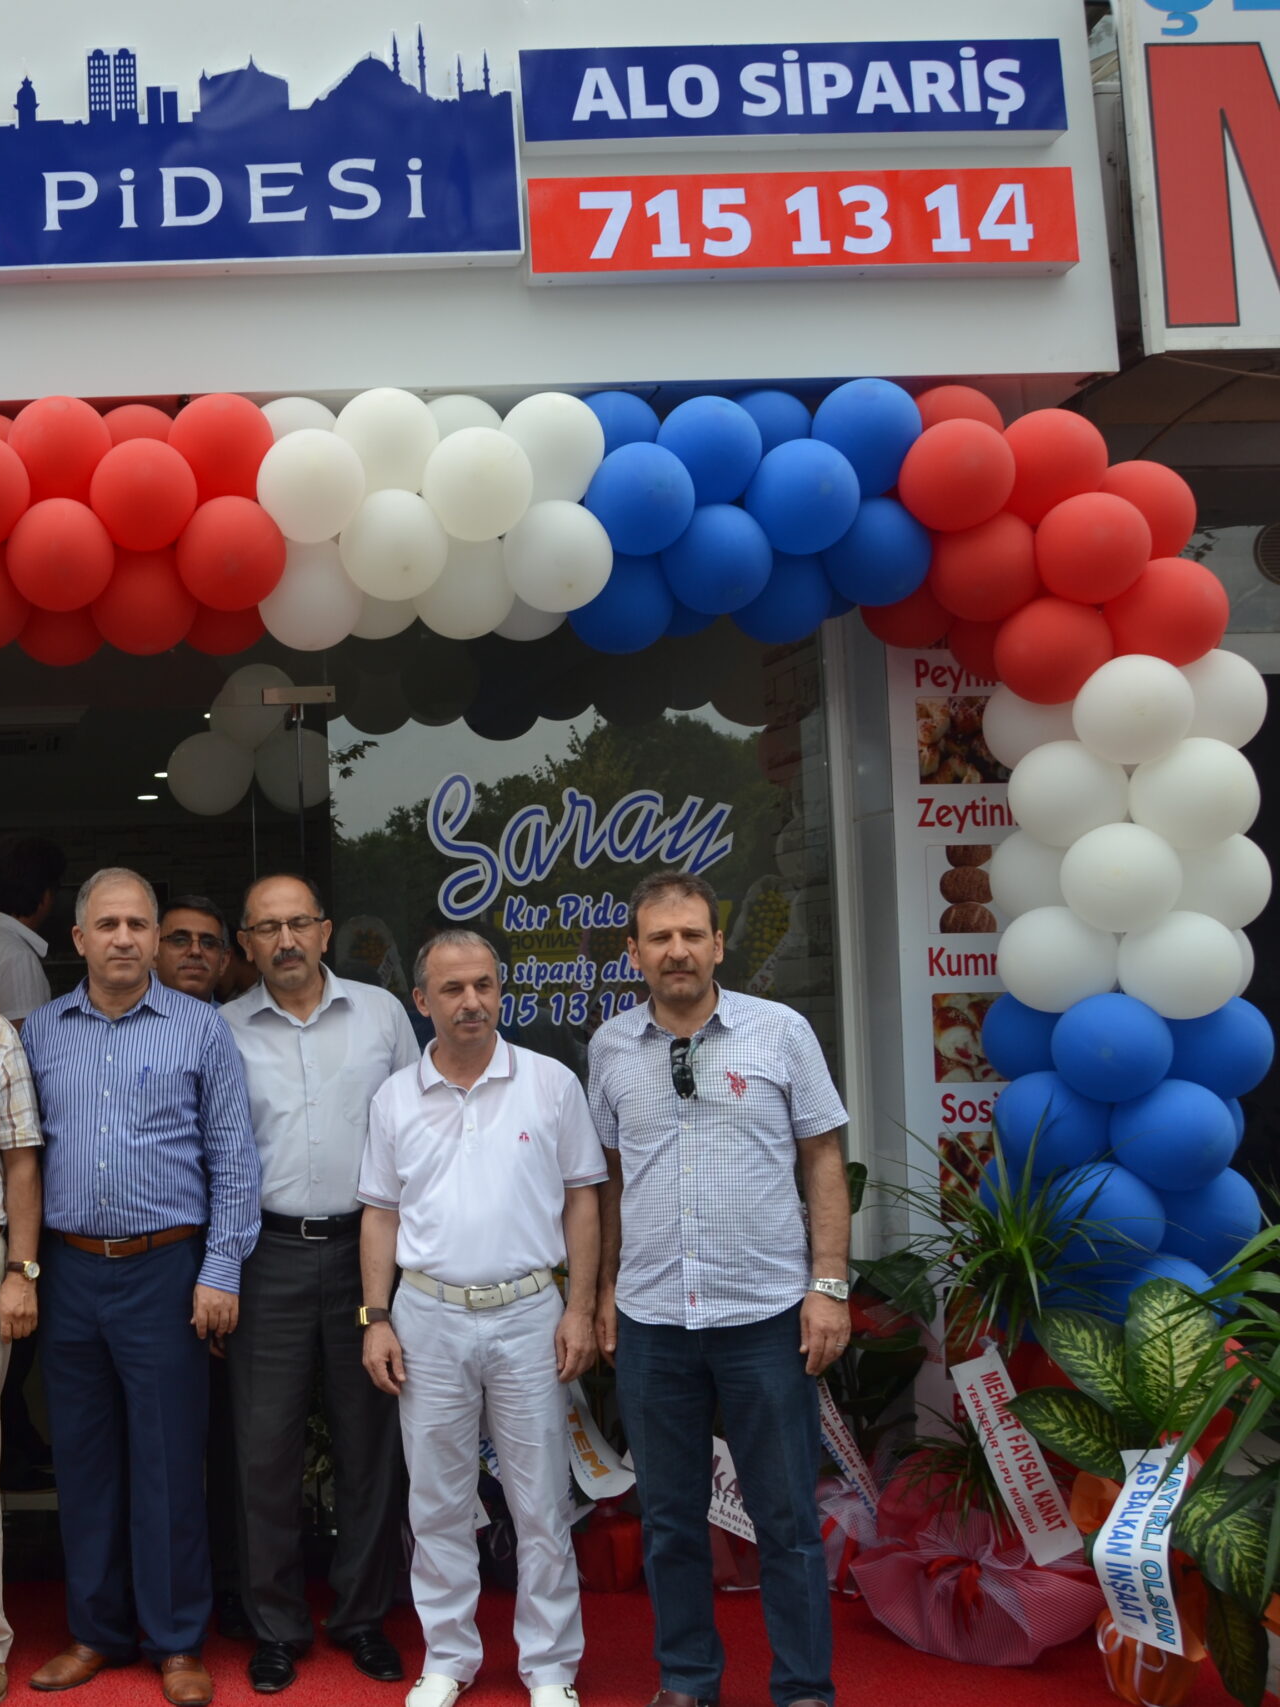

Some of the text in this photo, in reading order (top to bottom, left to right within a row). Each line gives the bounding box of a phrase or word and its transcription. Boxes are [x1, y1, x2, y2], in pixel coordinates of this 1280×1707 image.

[572, 45, 1027, 126] ALO SİPARİŞ
[577, 182, 1035, 261] 715 13 14
[426, 771, 735, 921] Saray
[916, 795, 1019, 834] Zeytinl
[557, 891, 629, 930] Pide
[927, 946, 999, 977] Kumr
[500, 991, 539, 1027] 15
[549, 991, 589, 1026] 13
[994, 1451, 1014, 1485] TAPU
[1008, 1487, 1039, 1535] MÜDÜRÜ
[1007, 1434, 1045, 1492] FAYSAL
[1031, 1488, 1068, 1533] KANAT
[1105, 1490, 1155, 1558] BALKAN
[1103, 1560, 1148, 1626] İNŞAAT
[1140, 1559, 1176, 1646] OLSUN
